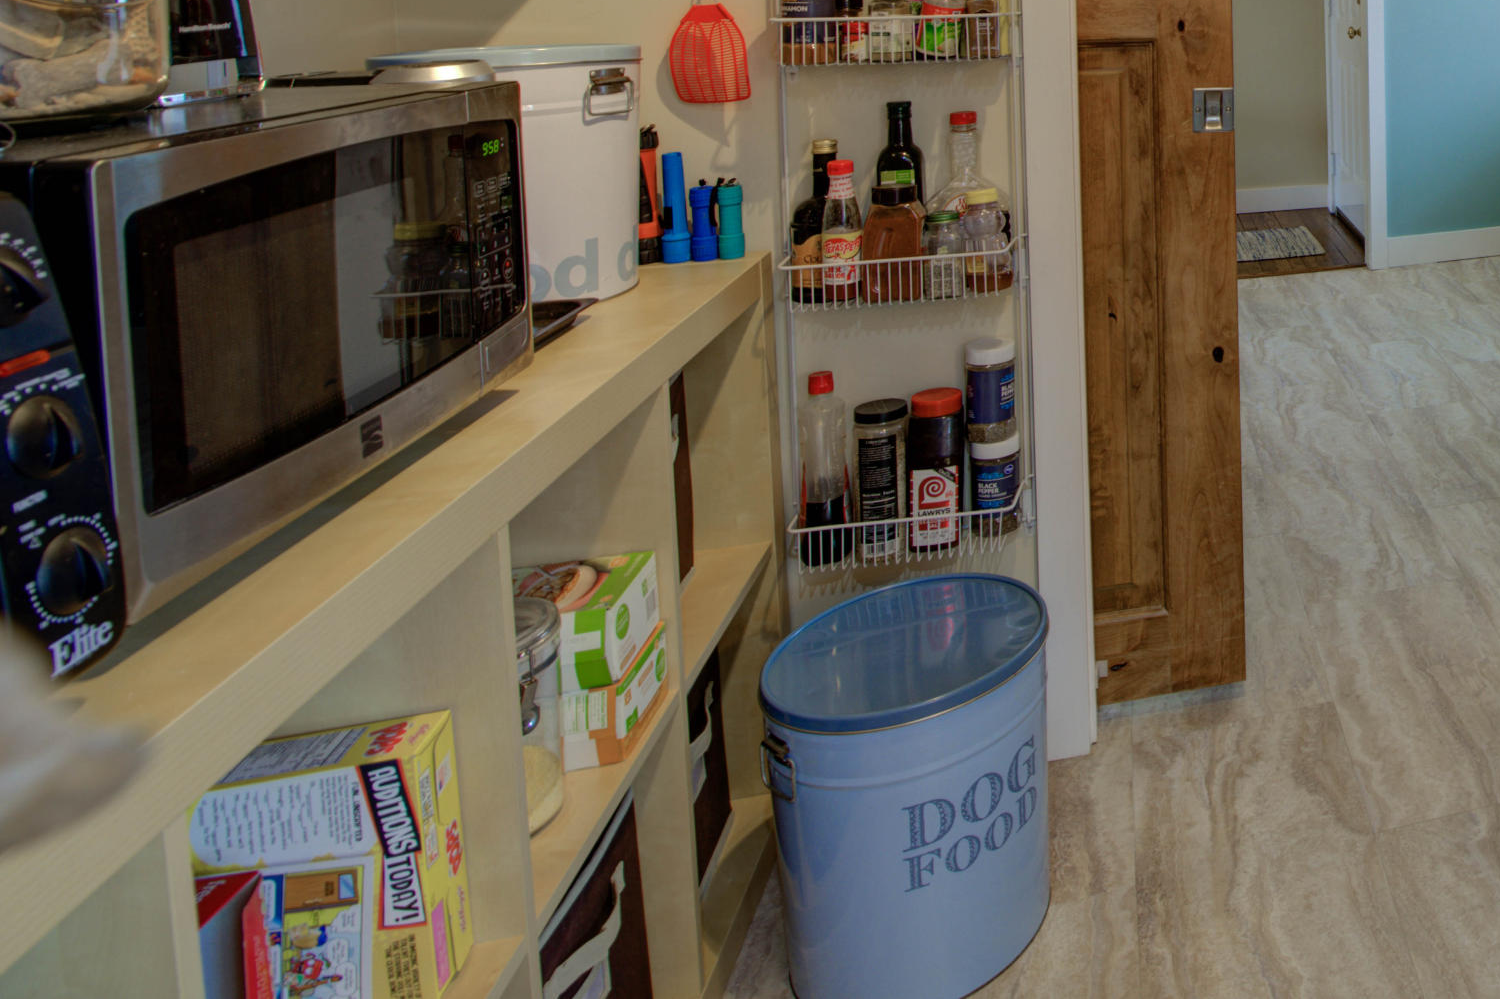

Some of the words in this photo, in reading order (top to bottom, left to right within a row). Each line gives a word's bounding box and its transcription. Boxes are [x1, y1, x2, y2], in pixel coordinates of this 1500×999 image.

[977, 482, 998, 490] BLACK
[977, 487, 999, 495] PEPPER
[49, 620, 114, 679] Elite
[364, 721, 408, 757] POPS
[368, 764, 415, 858] AUDITIONS
[901, 735, 1037, 854] DOG
[903, 785, 1038, 893] FOOD
[385, 852, 421, 925] TODAY!
